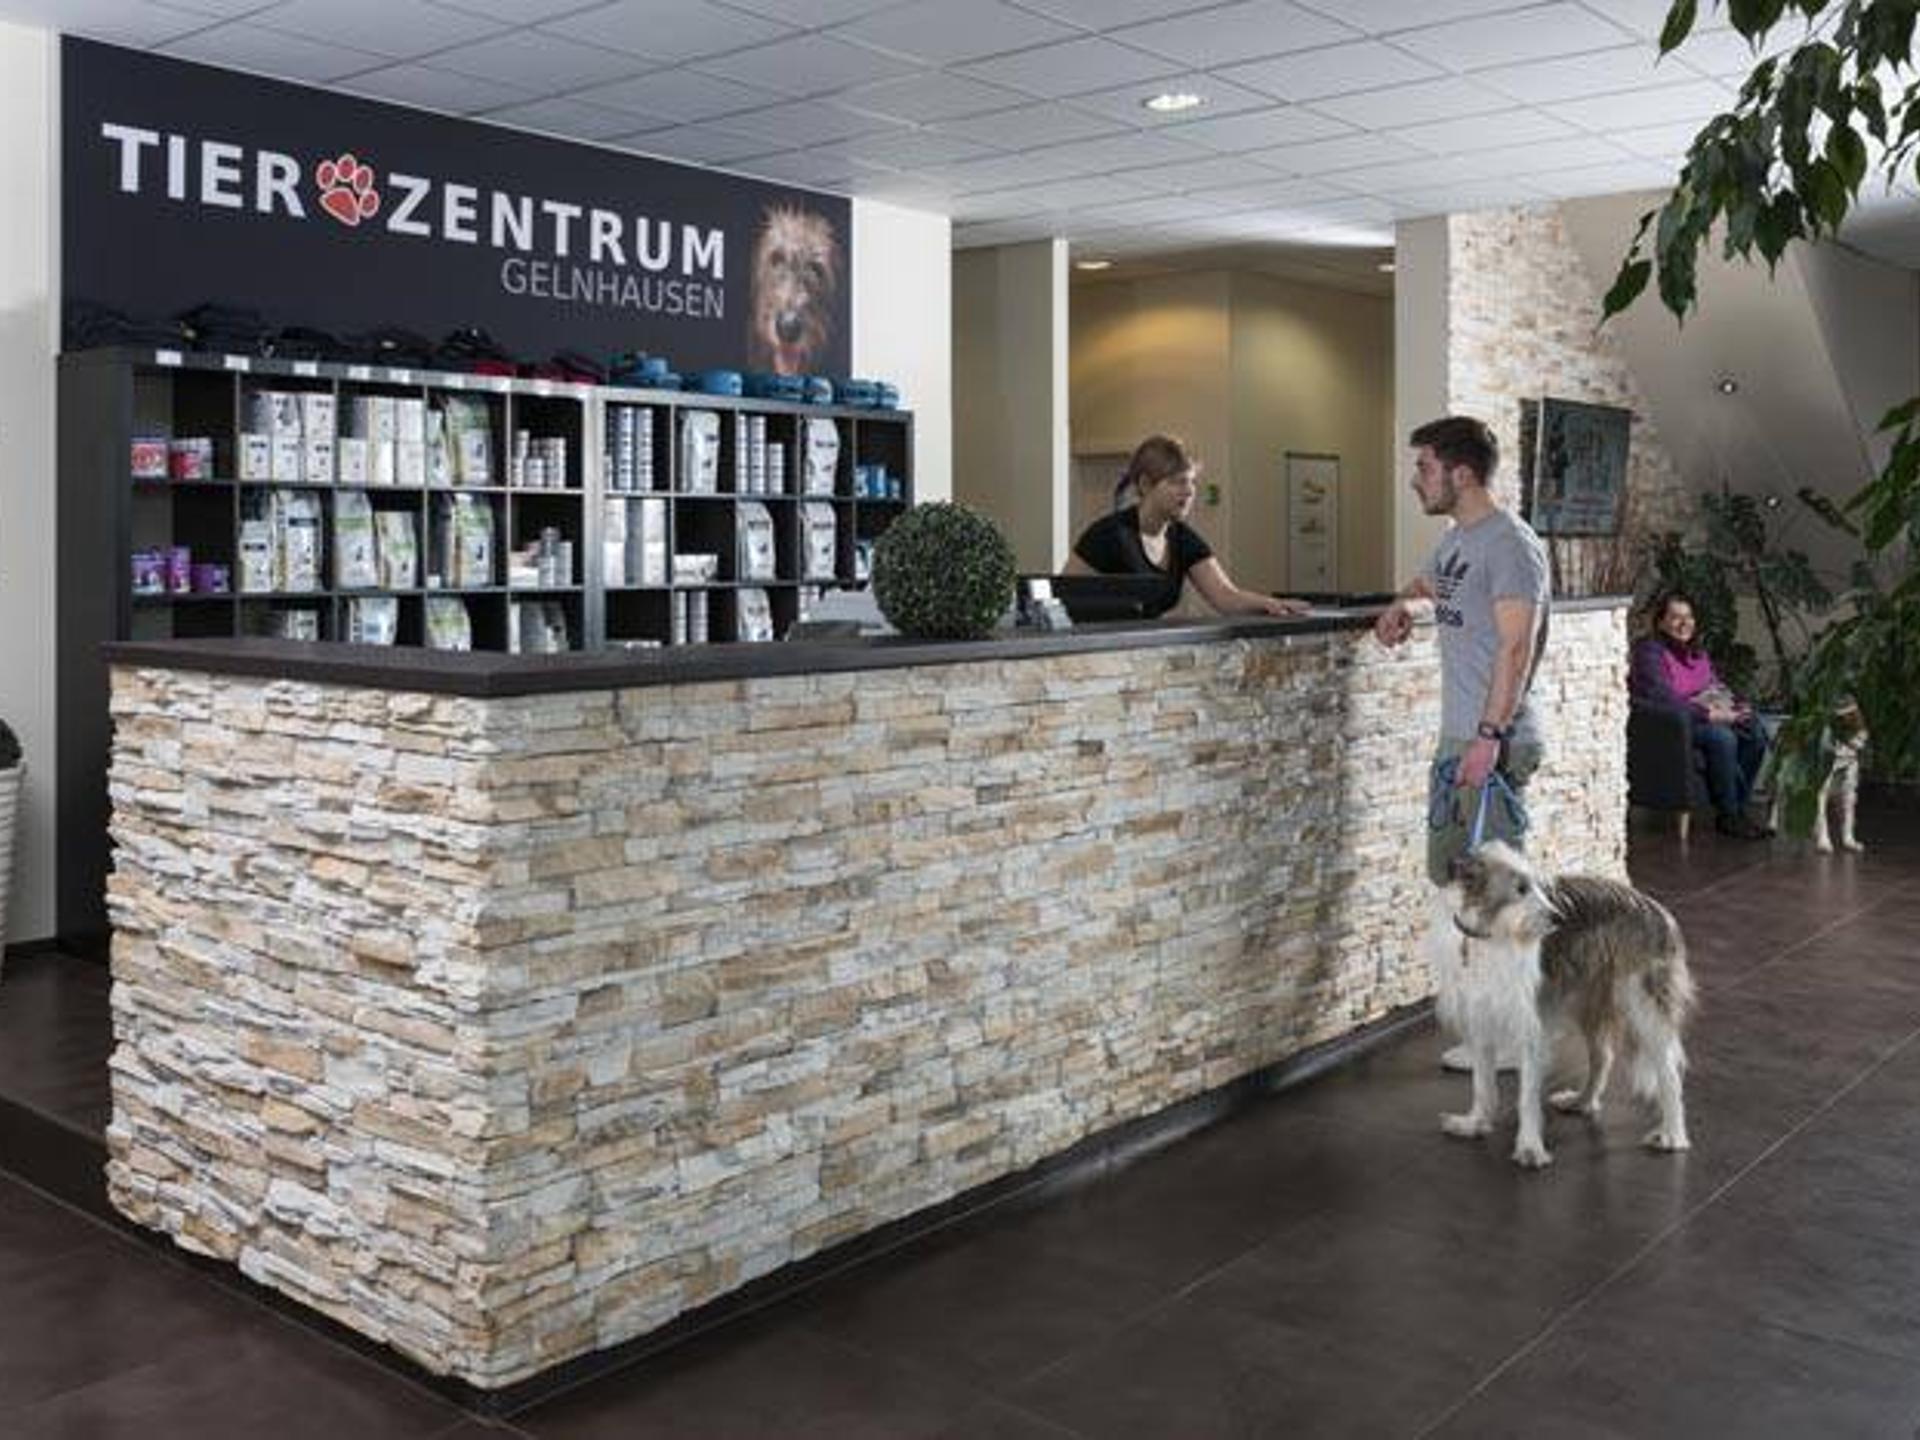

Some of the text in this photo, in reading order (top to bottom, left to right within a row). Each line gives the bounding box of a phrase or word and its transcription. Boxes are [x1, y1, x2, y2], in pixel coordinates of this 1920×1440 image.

[102, 122, 725, 279] TIER ZENTRUM
[501, 257, 725, 319] GELNHAUSEN
